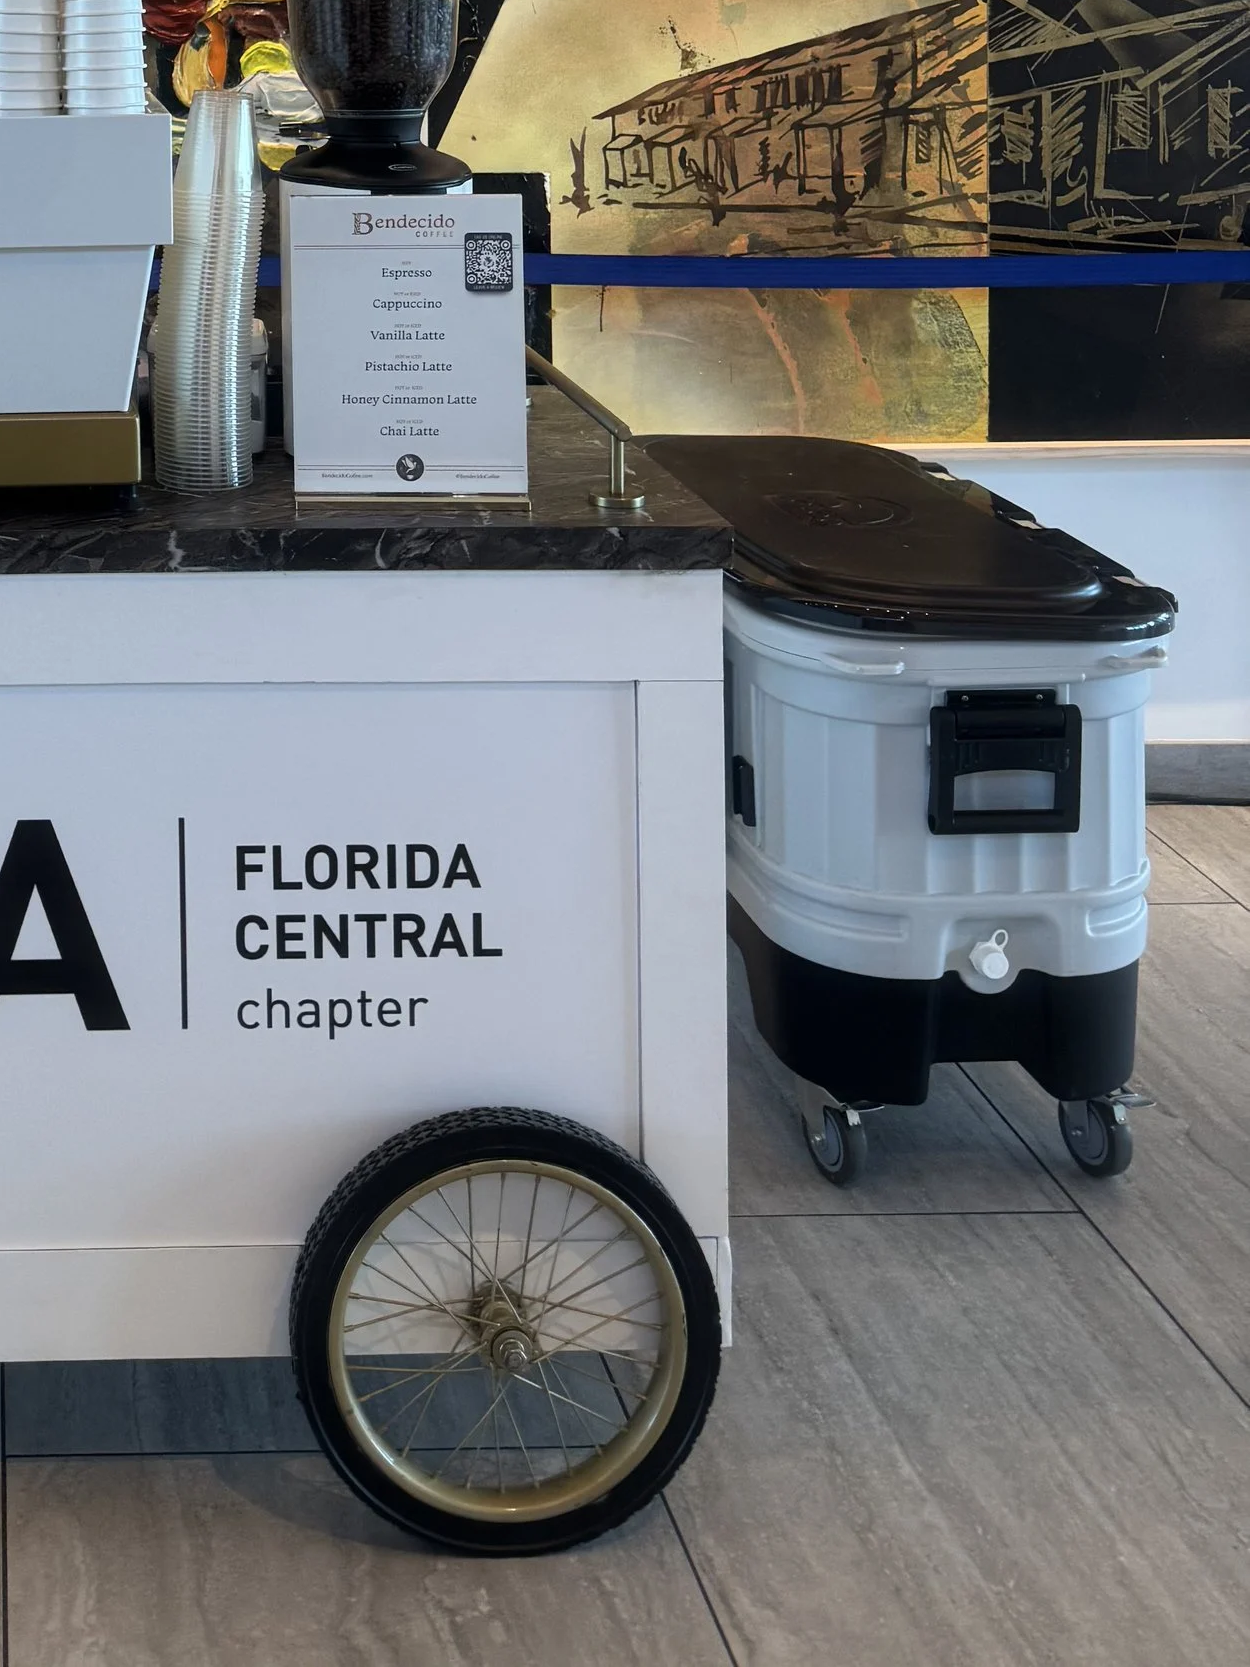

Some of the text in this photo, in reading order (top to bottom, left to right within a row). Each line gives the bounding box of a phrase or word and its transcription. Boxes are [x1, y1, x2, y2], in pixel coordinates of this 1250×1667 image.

[352, 212, 456, 235] Bendecido
[381, 267, 433, 280] Espresso
[372, 298, 443, 311] Cappuccino
[370, 330, 446, 340] Vanilla Latte
[365, 361, 452, 372] Pistachio Latte
[342, 394, 477, 407] Honey Cinnamon Latte
[379, 426, 440, 436] Chai Latte
[235, 842, 481, 892] FLORIDA
[234, 912, 504, 961] CENTRAL
[235, 988, 431, 1039] chapter
